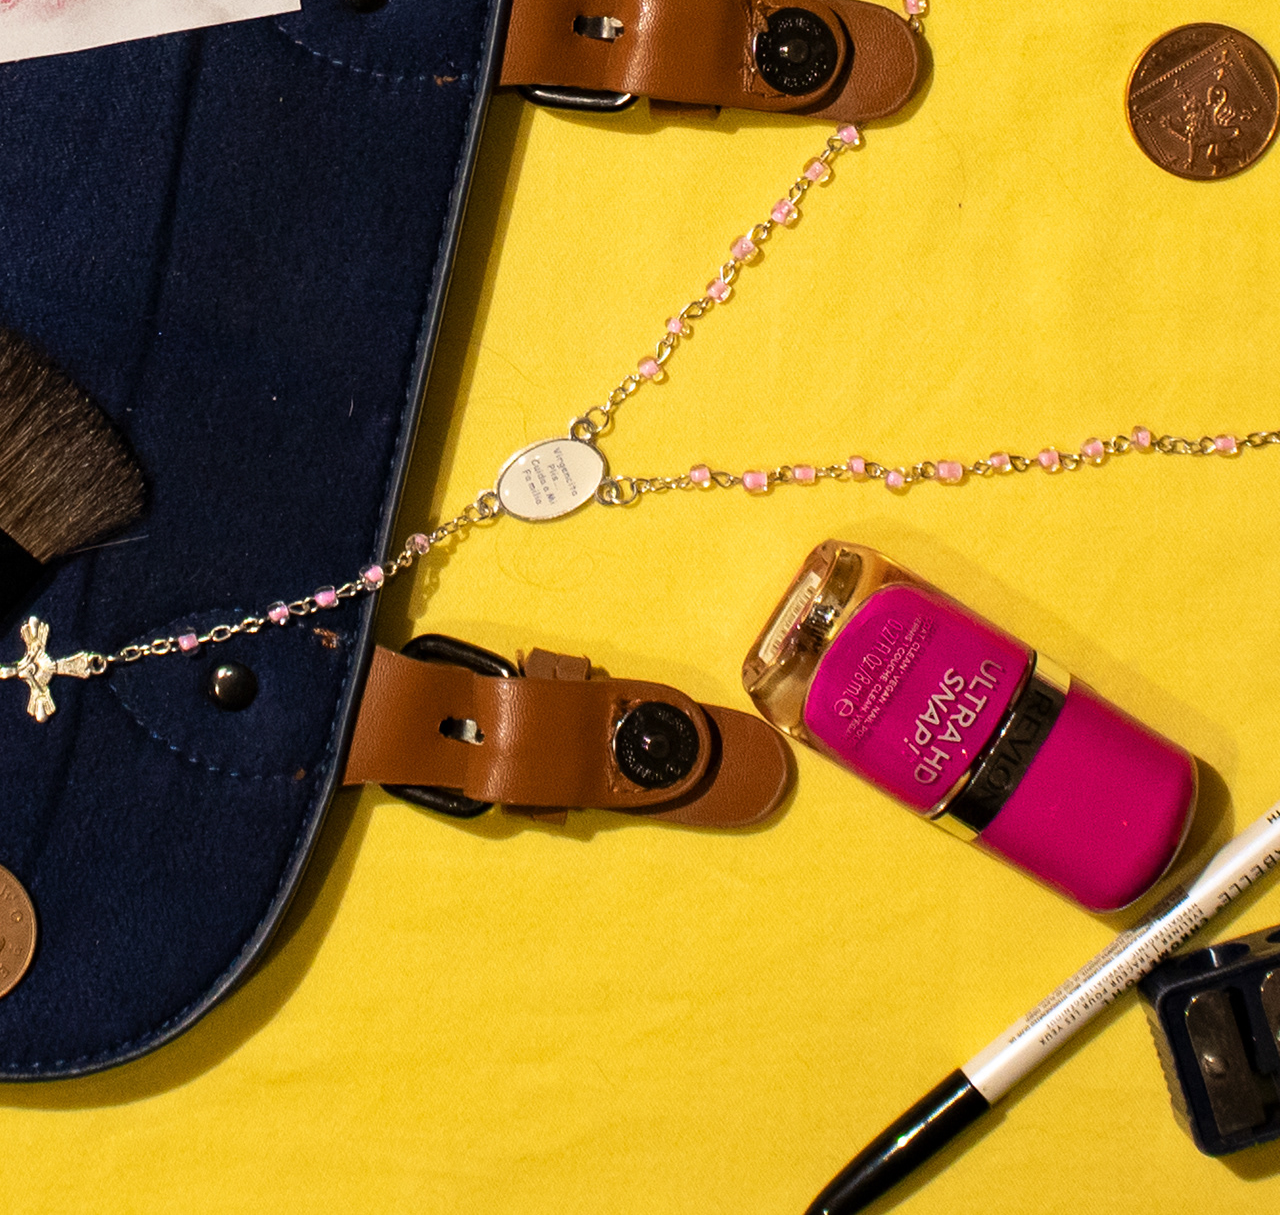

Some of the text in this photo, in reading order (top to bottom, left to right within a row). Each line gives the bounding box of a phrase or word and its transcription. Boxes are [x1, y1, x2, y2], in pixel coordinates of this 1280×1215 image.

[531, 459, 547, 485] Cuida
[903, 668, 965, 755] SNAP!
[914, 659, 1002, 784] ULTRA HD
[979, 690, 1054, 806] REVLON
[1039, 907, 1205, 1046] EYELINER TRACEUR POUR LES YEUX
